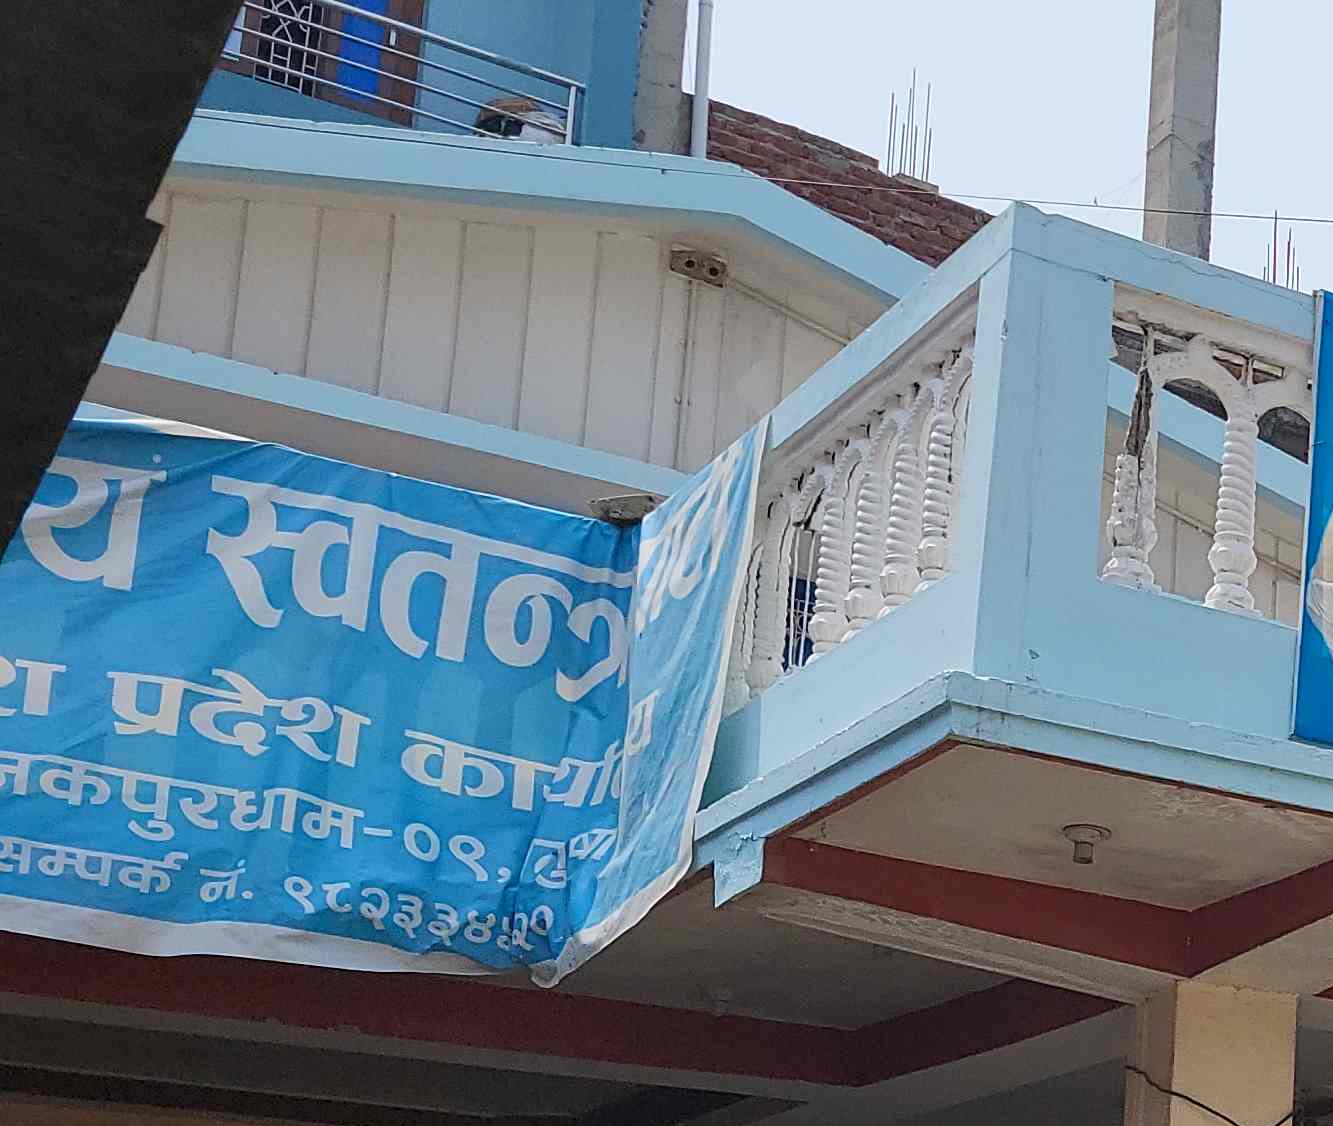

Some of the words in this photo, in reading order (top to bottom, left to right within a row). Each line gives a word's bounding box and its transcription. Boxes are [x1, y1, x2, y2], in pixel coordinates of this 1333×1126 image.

[107, 667, 371, 768] प्रदेश
[0, 749, 512, 883] नकपुरधाम-०९,
[0, 836, 188, 895] सम्पर्क
[200, 859, 254, 903] नं.
